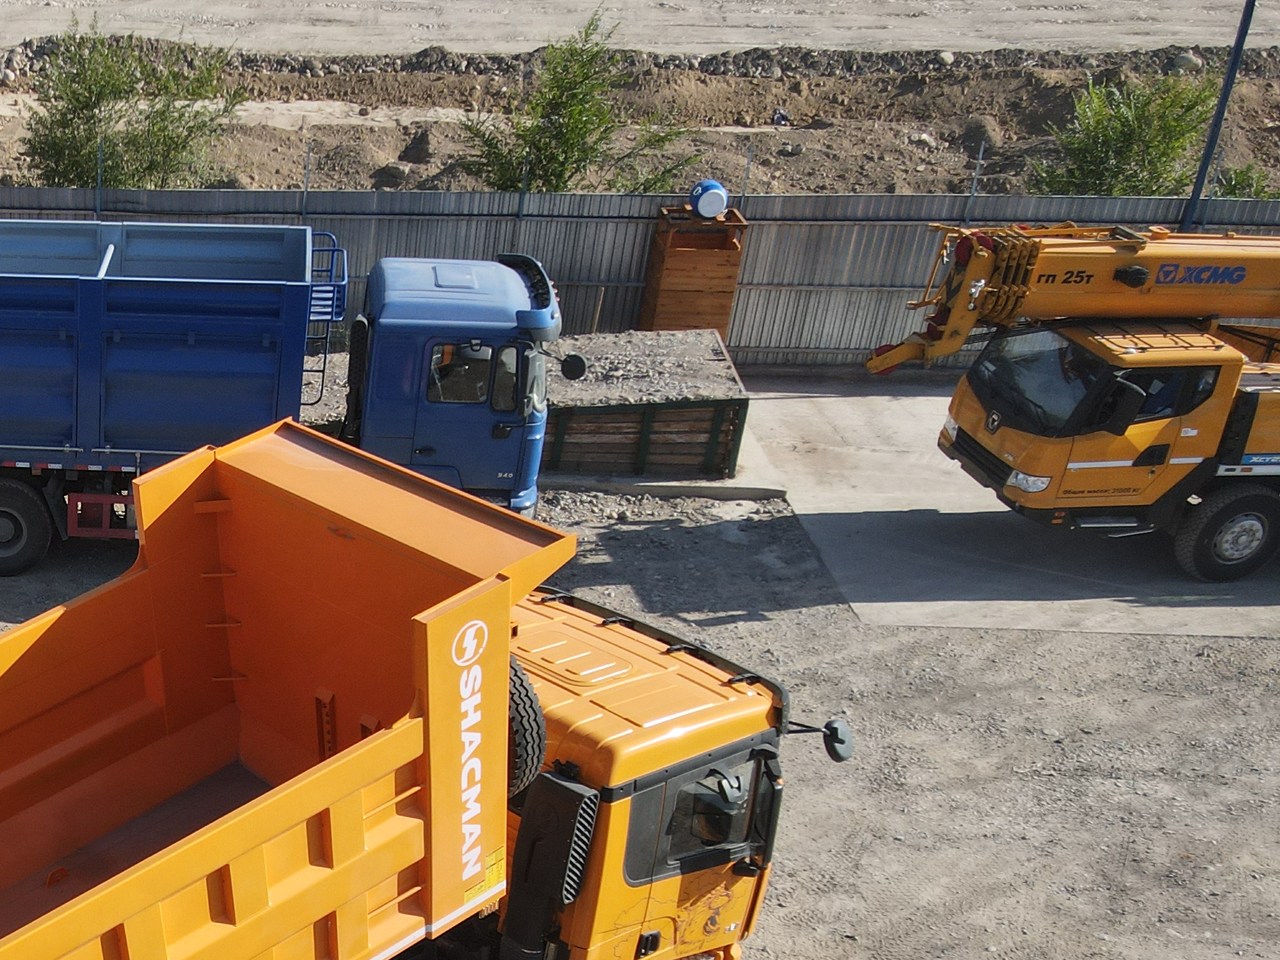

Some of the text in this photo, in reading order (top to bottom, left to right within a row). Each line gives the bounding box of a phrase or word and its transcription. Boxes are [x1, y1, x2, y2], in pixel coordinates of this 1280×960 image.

[1061, 270, 1094, 284] 25т
[1179, 265, 1247, 285] XCMG
[459, 664, 483, 881] SHACMAN
